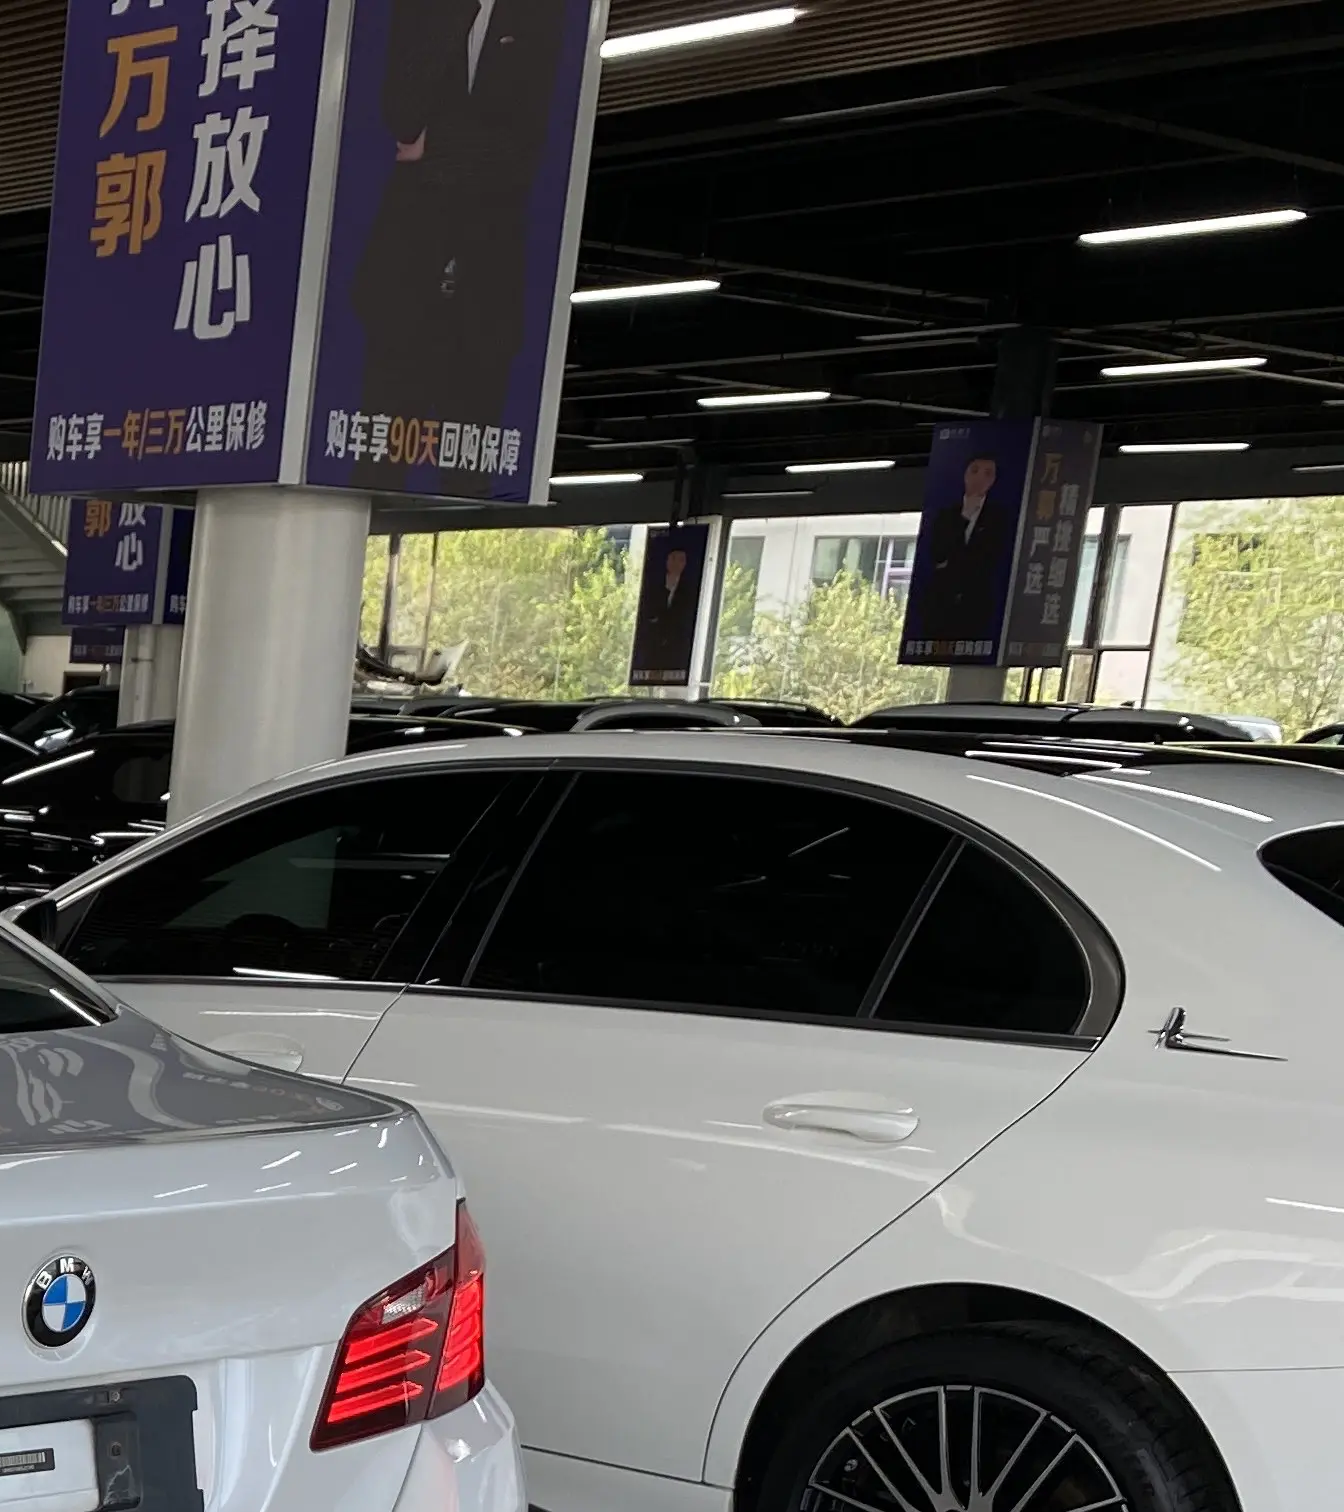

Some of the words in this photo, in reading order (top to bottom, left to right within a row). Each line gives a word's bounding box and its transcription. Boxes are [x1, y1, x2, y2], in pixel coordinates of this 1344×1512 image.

[89, 0, 178, 257] 万郭
[174, 0, 278, 340] 择放心
[47, 401, 268, 460] 购车享一年/三万公里保修
[324, 409, 521, 476] 购车享90天回购保障
[37, 1257, 94, 1289] BMW
